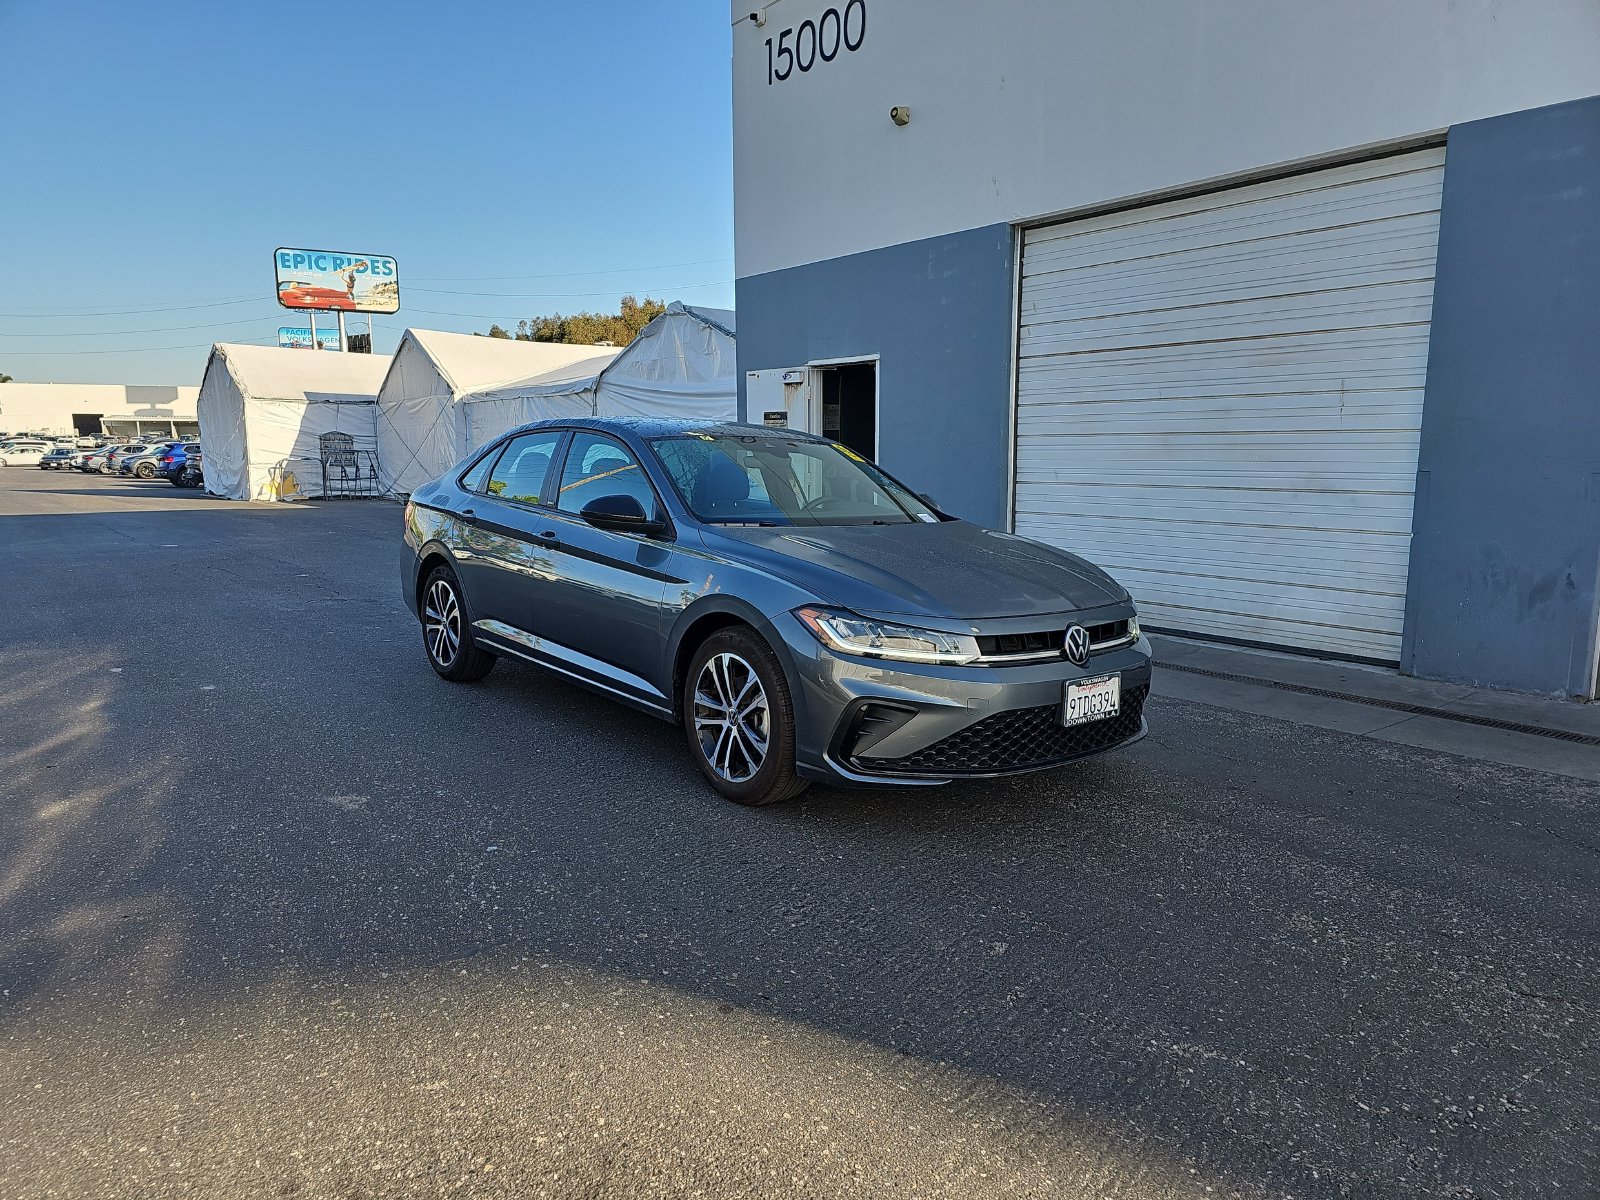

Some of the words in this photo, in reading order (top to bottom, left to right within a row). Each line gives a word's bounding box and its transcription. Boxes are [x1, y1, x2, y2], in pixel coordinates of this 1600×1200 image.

[764, 0, 866, 86] 15000
[280, 252, 328, 272] EPIC
[287, 336, 341, 344] VOLKSAGEN
[1070, 690, 1116, 719] 9TDG394
[1068, 712, 1105, 726] DOWNTOWN
